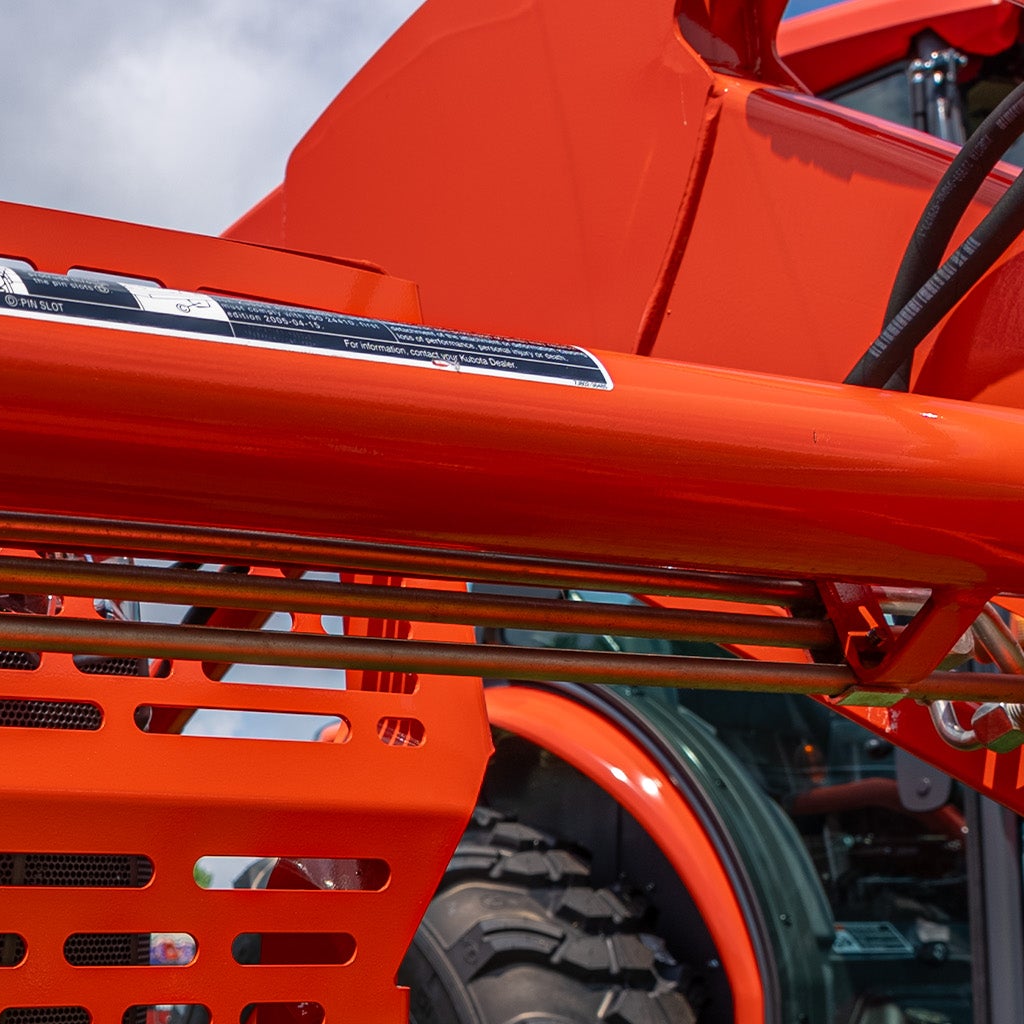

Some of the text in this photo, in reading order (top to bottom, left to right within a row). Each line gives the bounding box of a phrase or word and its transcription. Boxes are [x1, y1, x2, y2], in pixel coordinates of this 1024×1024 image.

[32, 278, 50, 286] the
[52, 281, 68, 289] pin
[39, 300, 64, 312] SLOT
[226, 311, 262, 322] edition
[306, 314, 324, 322] ISO
[397, 333, 415, 342] loss
[478, 345, 510, 354] personal
[512, 348, 534, 359] injury
[544, 353, 569, 362] death.
[343, 339, 518, 369] For information, contact your Kubota Dealer.
